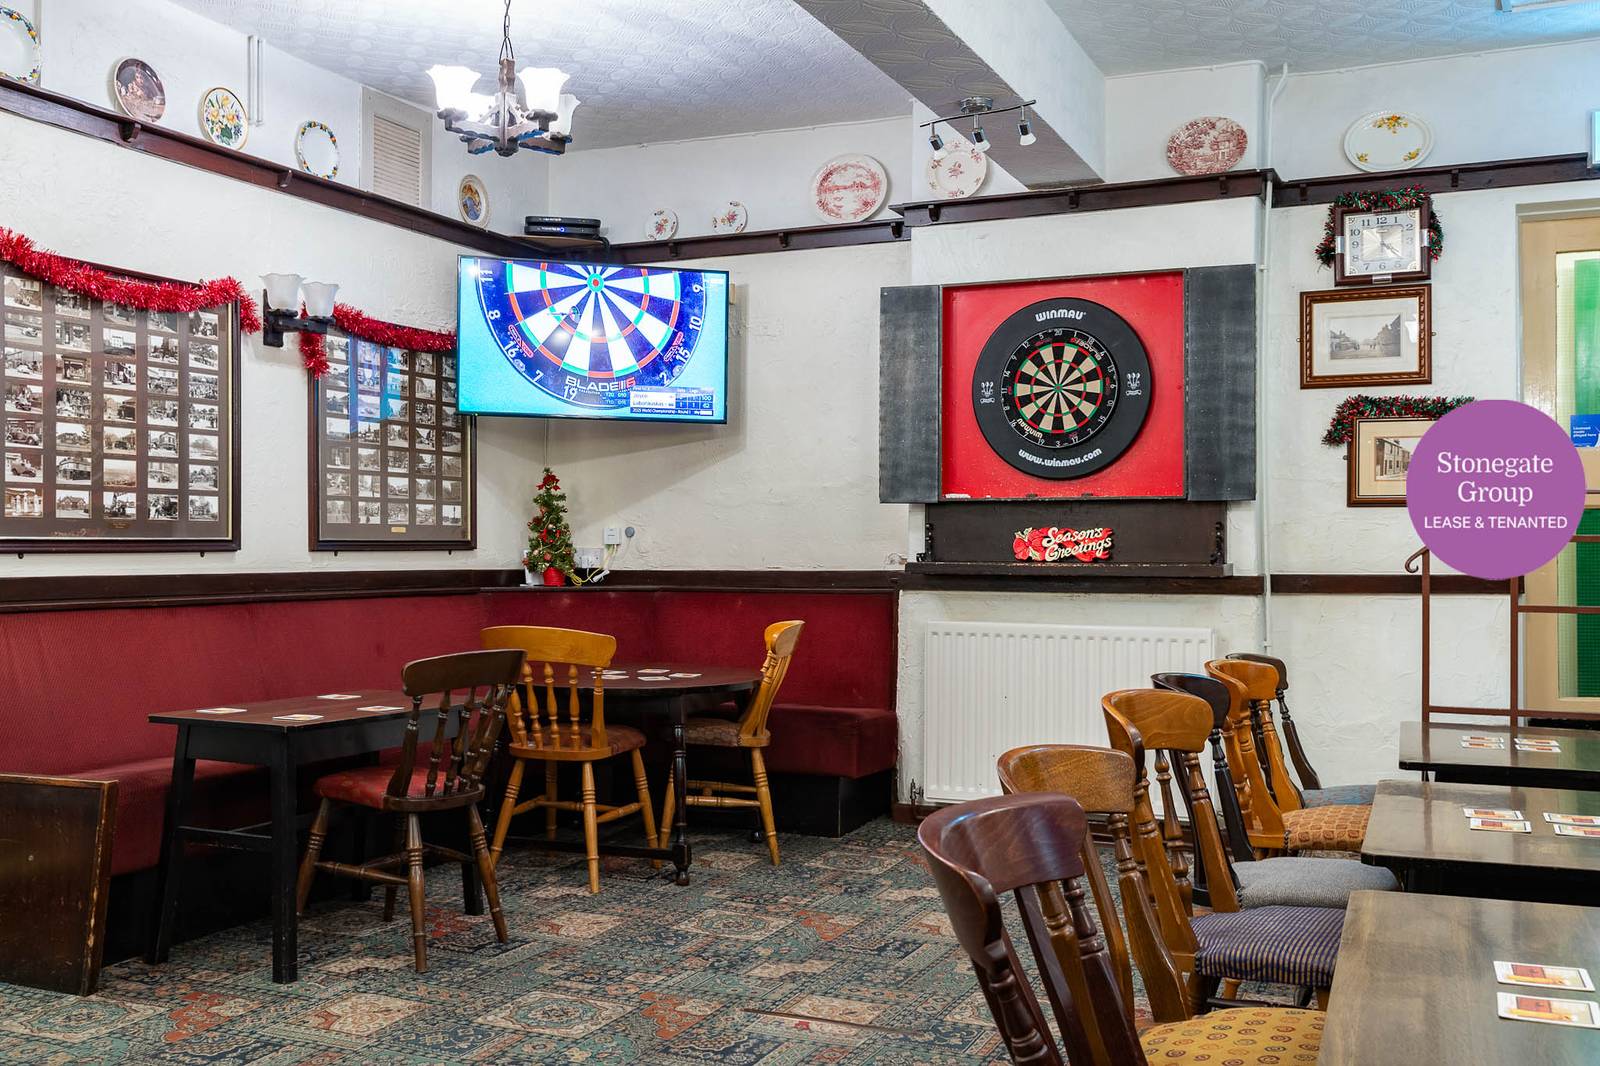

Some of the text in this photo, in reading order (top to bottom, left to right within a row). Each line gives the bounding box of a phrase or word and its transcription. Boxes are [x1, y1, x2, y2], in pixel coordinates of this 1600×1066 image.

[1361, 219, 1370, 227] 11
[1376, 217, 1388, 225] 12
[1394, 216, 1398, 224] 1
[1351, 240, 1359, 249] 9
[480, 270, 494, 283] 11
[488, 309, 501, 320] 8
[689, 315, 701, 331] 10
[1087, 337, 1095, 346] 18
[504, 341, 519, 358] 16
[676, 347, 690, 364] 15
[1012, 353, 1018, 361] 9
[533, 369, 544, 382] 7
[659, 372, 670, 384] 2
[565, 375, 619, 392] BLADE
[563, 384, 578, 401] 19
[1107, 399, 1114, 407] 10
[1009, 420, 1016, 428] 16
[1098, 415, 1106, 424] 15
[1023, 430, 1029, 438] 7
[1087, 427, 1094, 435] 2
[1038, 437, 1045, 446] 19
[1071, 436, 1079, 444] 17
[1018, 447, 1103, 468] www.winmau.com
[1045, 537, 1112, 562] Greetings
